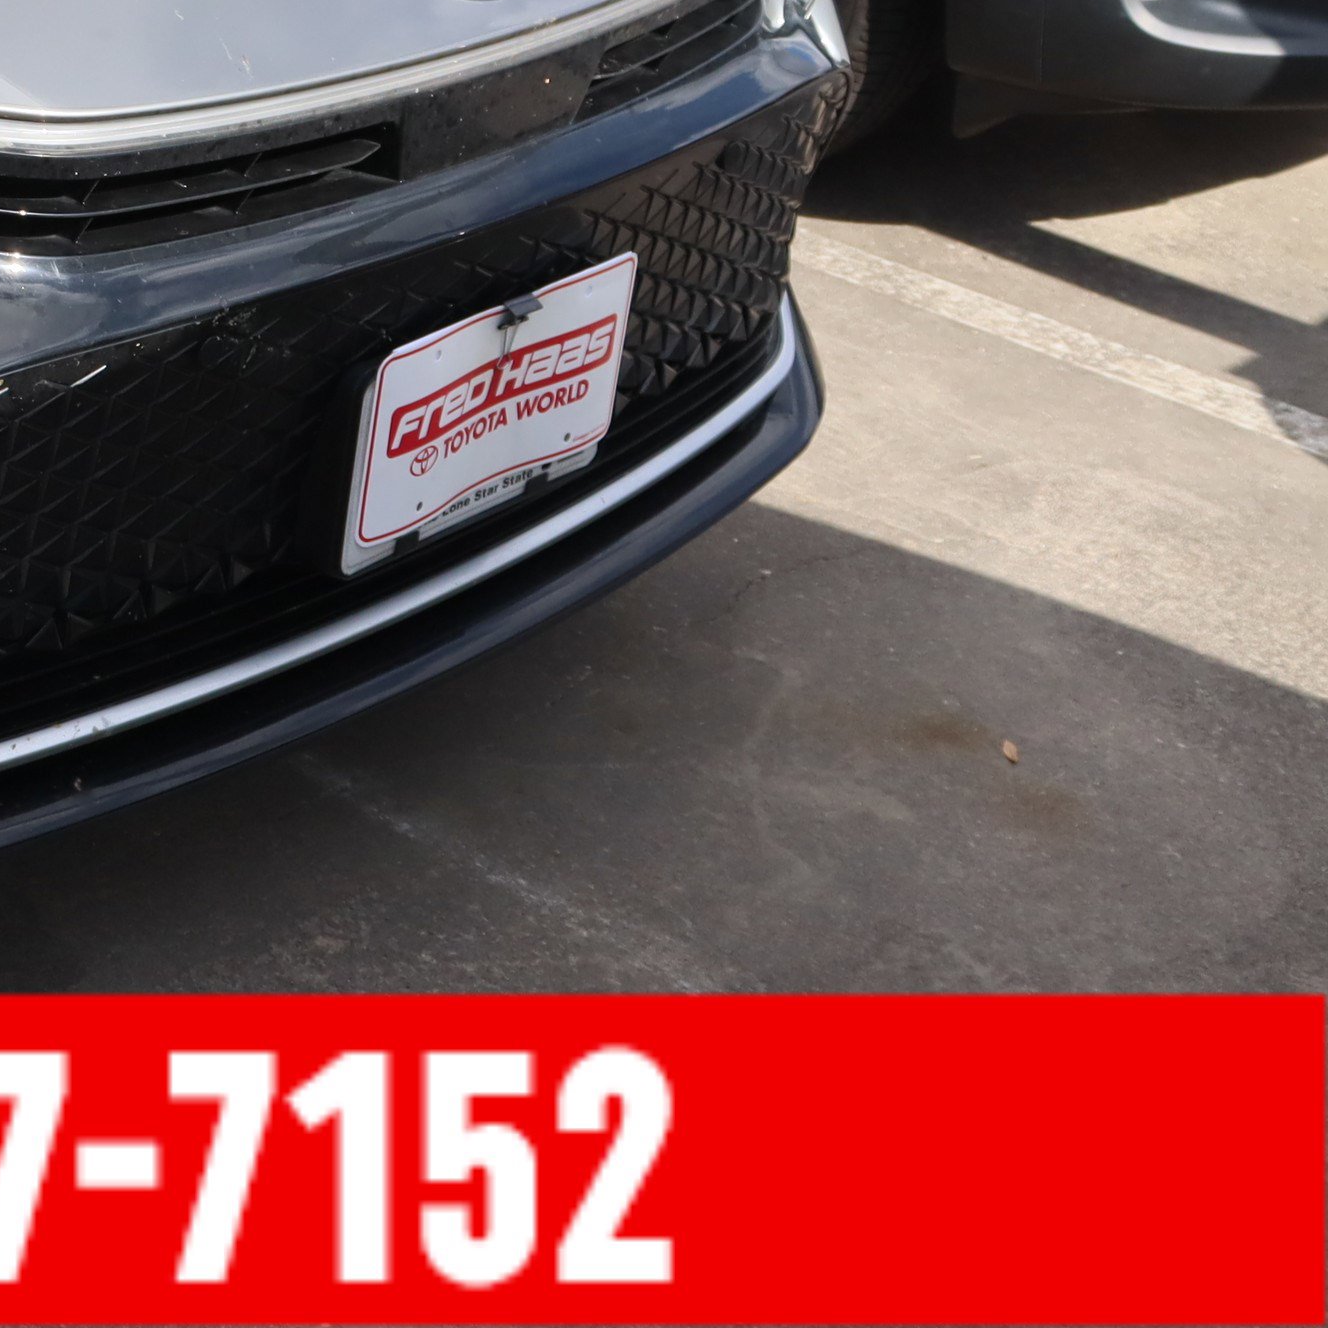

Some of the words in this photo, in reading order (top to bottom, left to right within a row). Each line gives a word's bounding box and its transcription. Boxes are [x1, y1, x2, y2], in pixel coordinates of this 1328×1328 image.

[444, 407, 507, 458] TOYOTA
[516, 379, 589, 421] WORLD
[474, 484, 499, 502] Star
[502, 469, 533, 491] State
